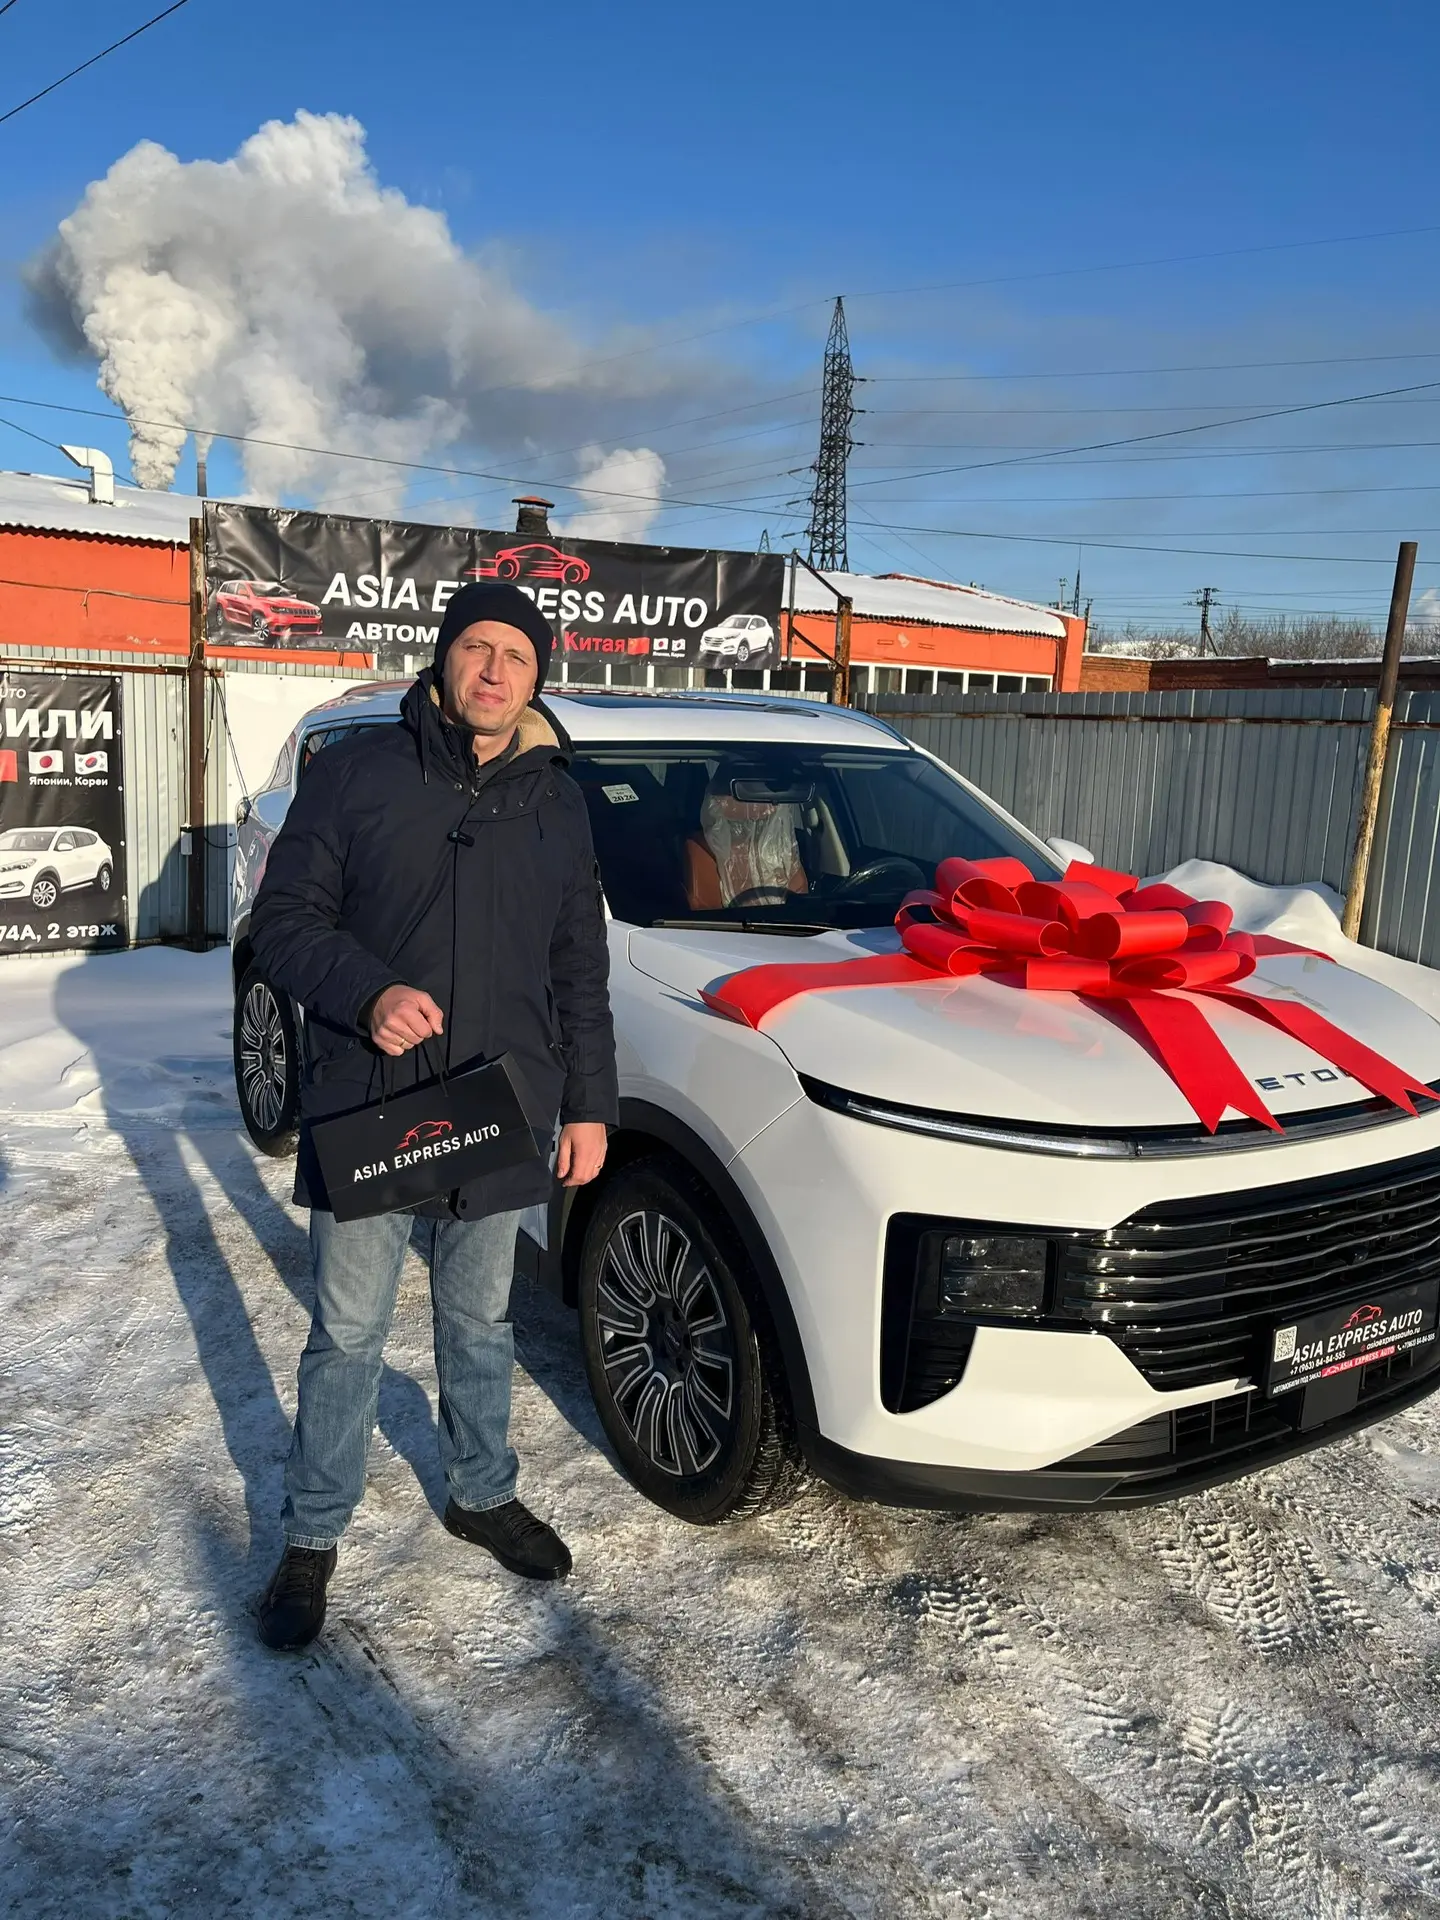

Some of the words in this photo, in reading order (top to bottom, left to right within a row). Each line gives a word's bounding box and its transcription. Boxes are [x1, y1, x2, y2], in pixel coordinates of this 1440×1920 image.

[320, 572, 420, 611] ASIA
[431, 580, 605, 623] EESS
[612, 593, 708, 628] AUTO
[345, 621, 440, 644] АВТОМ
[564, 631, 626, 653] Китая
[0, 708, 113, 740] ИЛИ
[29, 777, 73, 786] Японии,
[75, 776, 109, 787] Кореи
[47, 922, 60, 939] 2
[66, 924, 117, 938] этаж
[1254, 1065, 1350, 1091] ETO
[353, 1160, 388, 1182] ASIA
[393, 1136, 461, 1169] EXPRESS
[464, 1123, 500, 1147] AUTO
[1291, 1343, 1323, 1366] ASIA
[1327, 1319, 1388, 1353] EXPRESS
[1388, 1308, 1423, 1333] AUTO
[1315, 1350, 1346, 1367] 84-84-555
[1339, 1358, 1353, 1371] ASIA
[1354, 1350, 1380, 1366] EXPRESS
